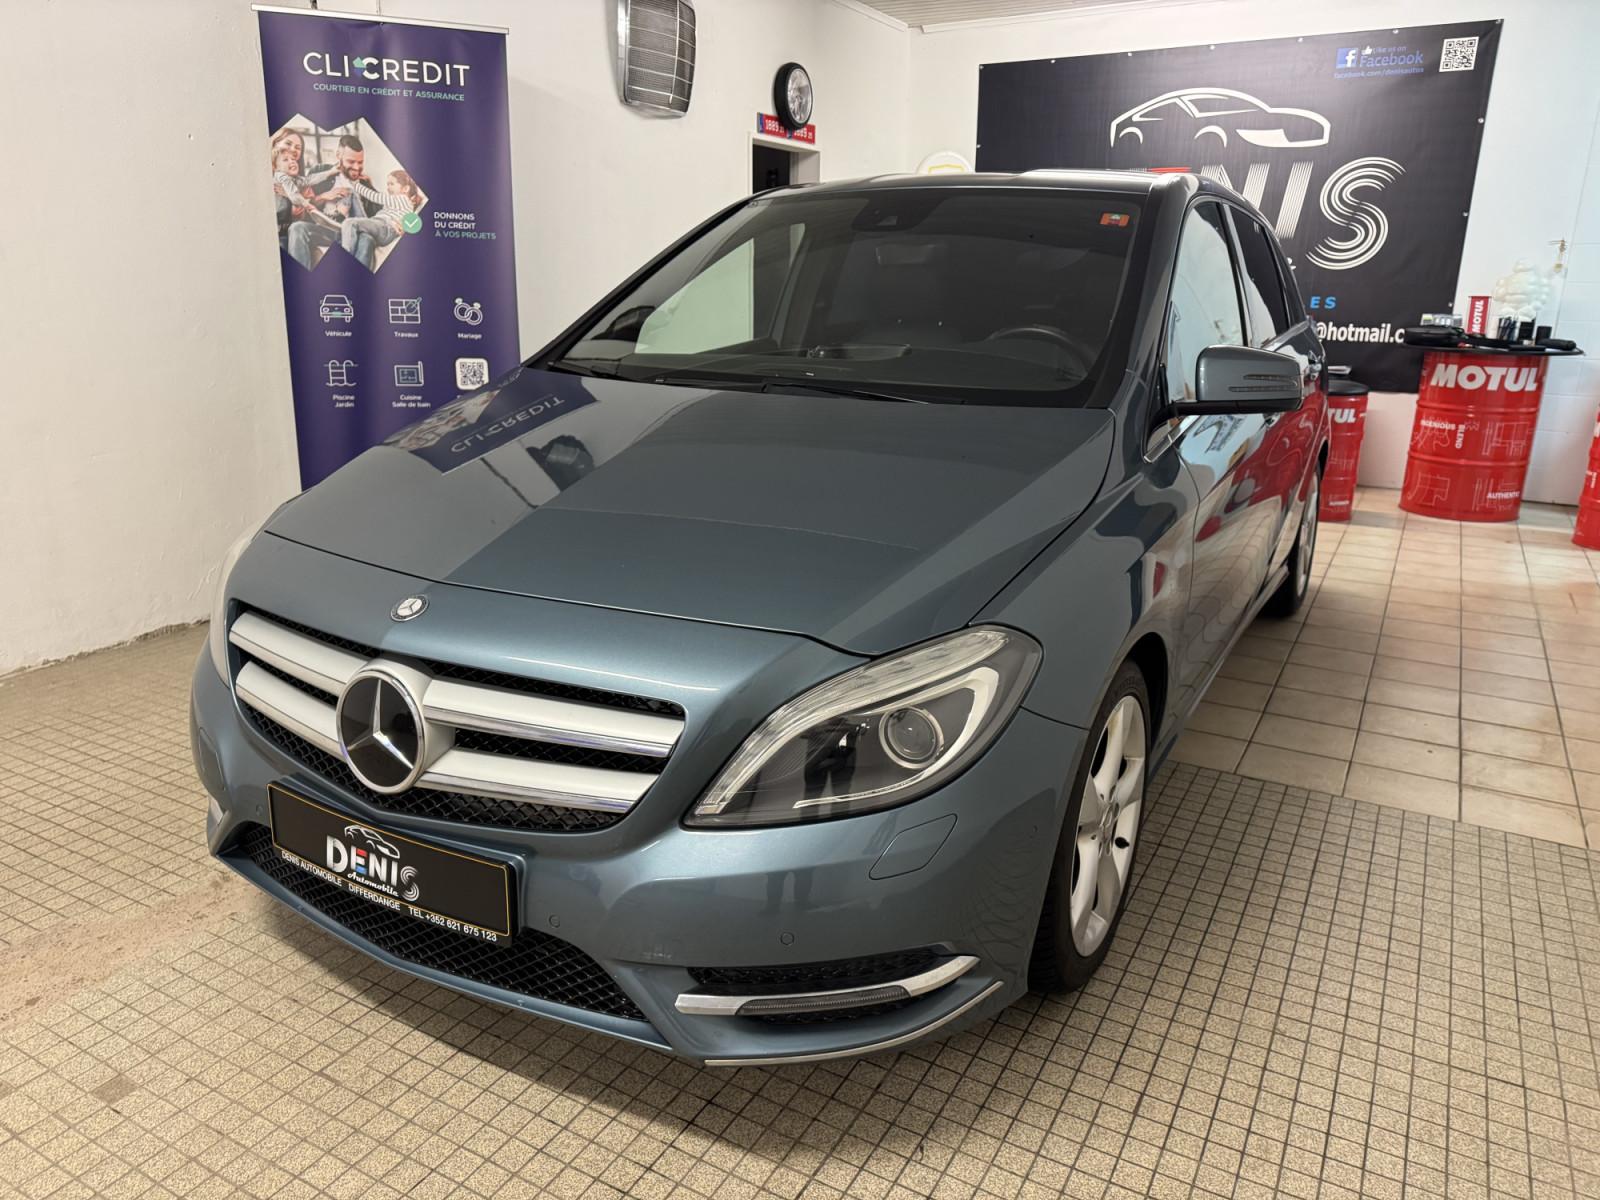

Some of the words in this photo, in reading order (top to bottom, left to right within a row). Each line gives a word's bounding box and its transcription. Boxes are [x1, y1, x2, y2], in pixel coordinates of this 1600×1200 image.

[1360, 50, 1424, 67] Facebook
[313, 83, 355, 94] COURTIER
[357, 87, 370, 95] EN
[415, 91, 465, 102] ASSURANCE
[433, 211, 475, 220] DONNONS
[434, 221, 446, 229] DU
[443, 230, 460, 238] VOS
[461, 231, 497, 240] PROJETS
[1471, 300, 1485, 334] MOTUL
[1430, 364, 1538, 392] MOTUL
[326, 834, 420, 902] DENIS
[347, 871, 399, 897] Automobile
[281, 850, 300, 866] DENIS
[300, 861, 342, 887] AUTOMOBILE
[348, 882, 401, 911] DIFFERDANGE
[408, 906, 424, 919] TEL
[425, 914, 446, 927] +352
[447, 919, 461, 931] 621
[463, 924, 480, 937] 675
[481, 930, 497, 942] 123
